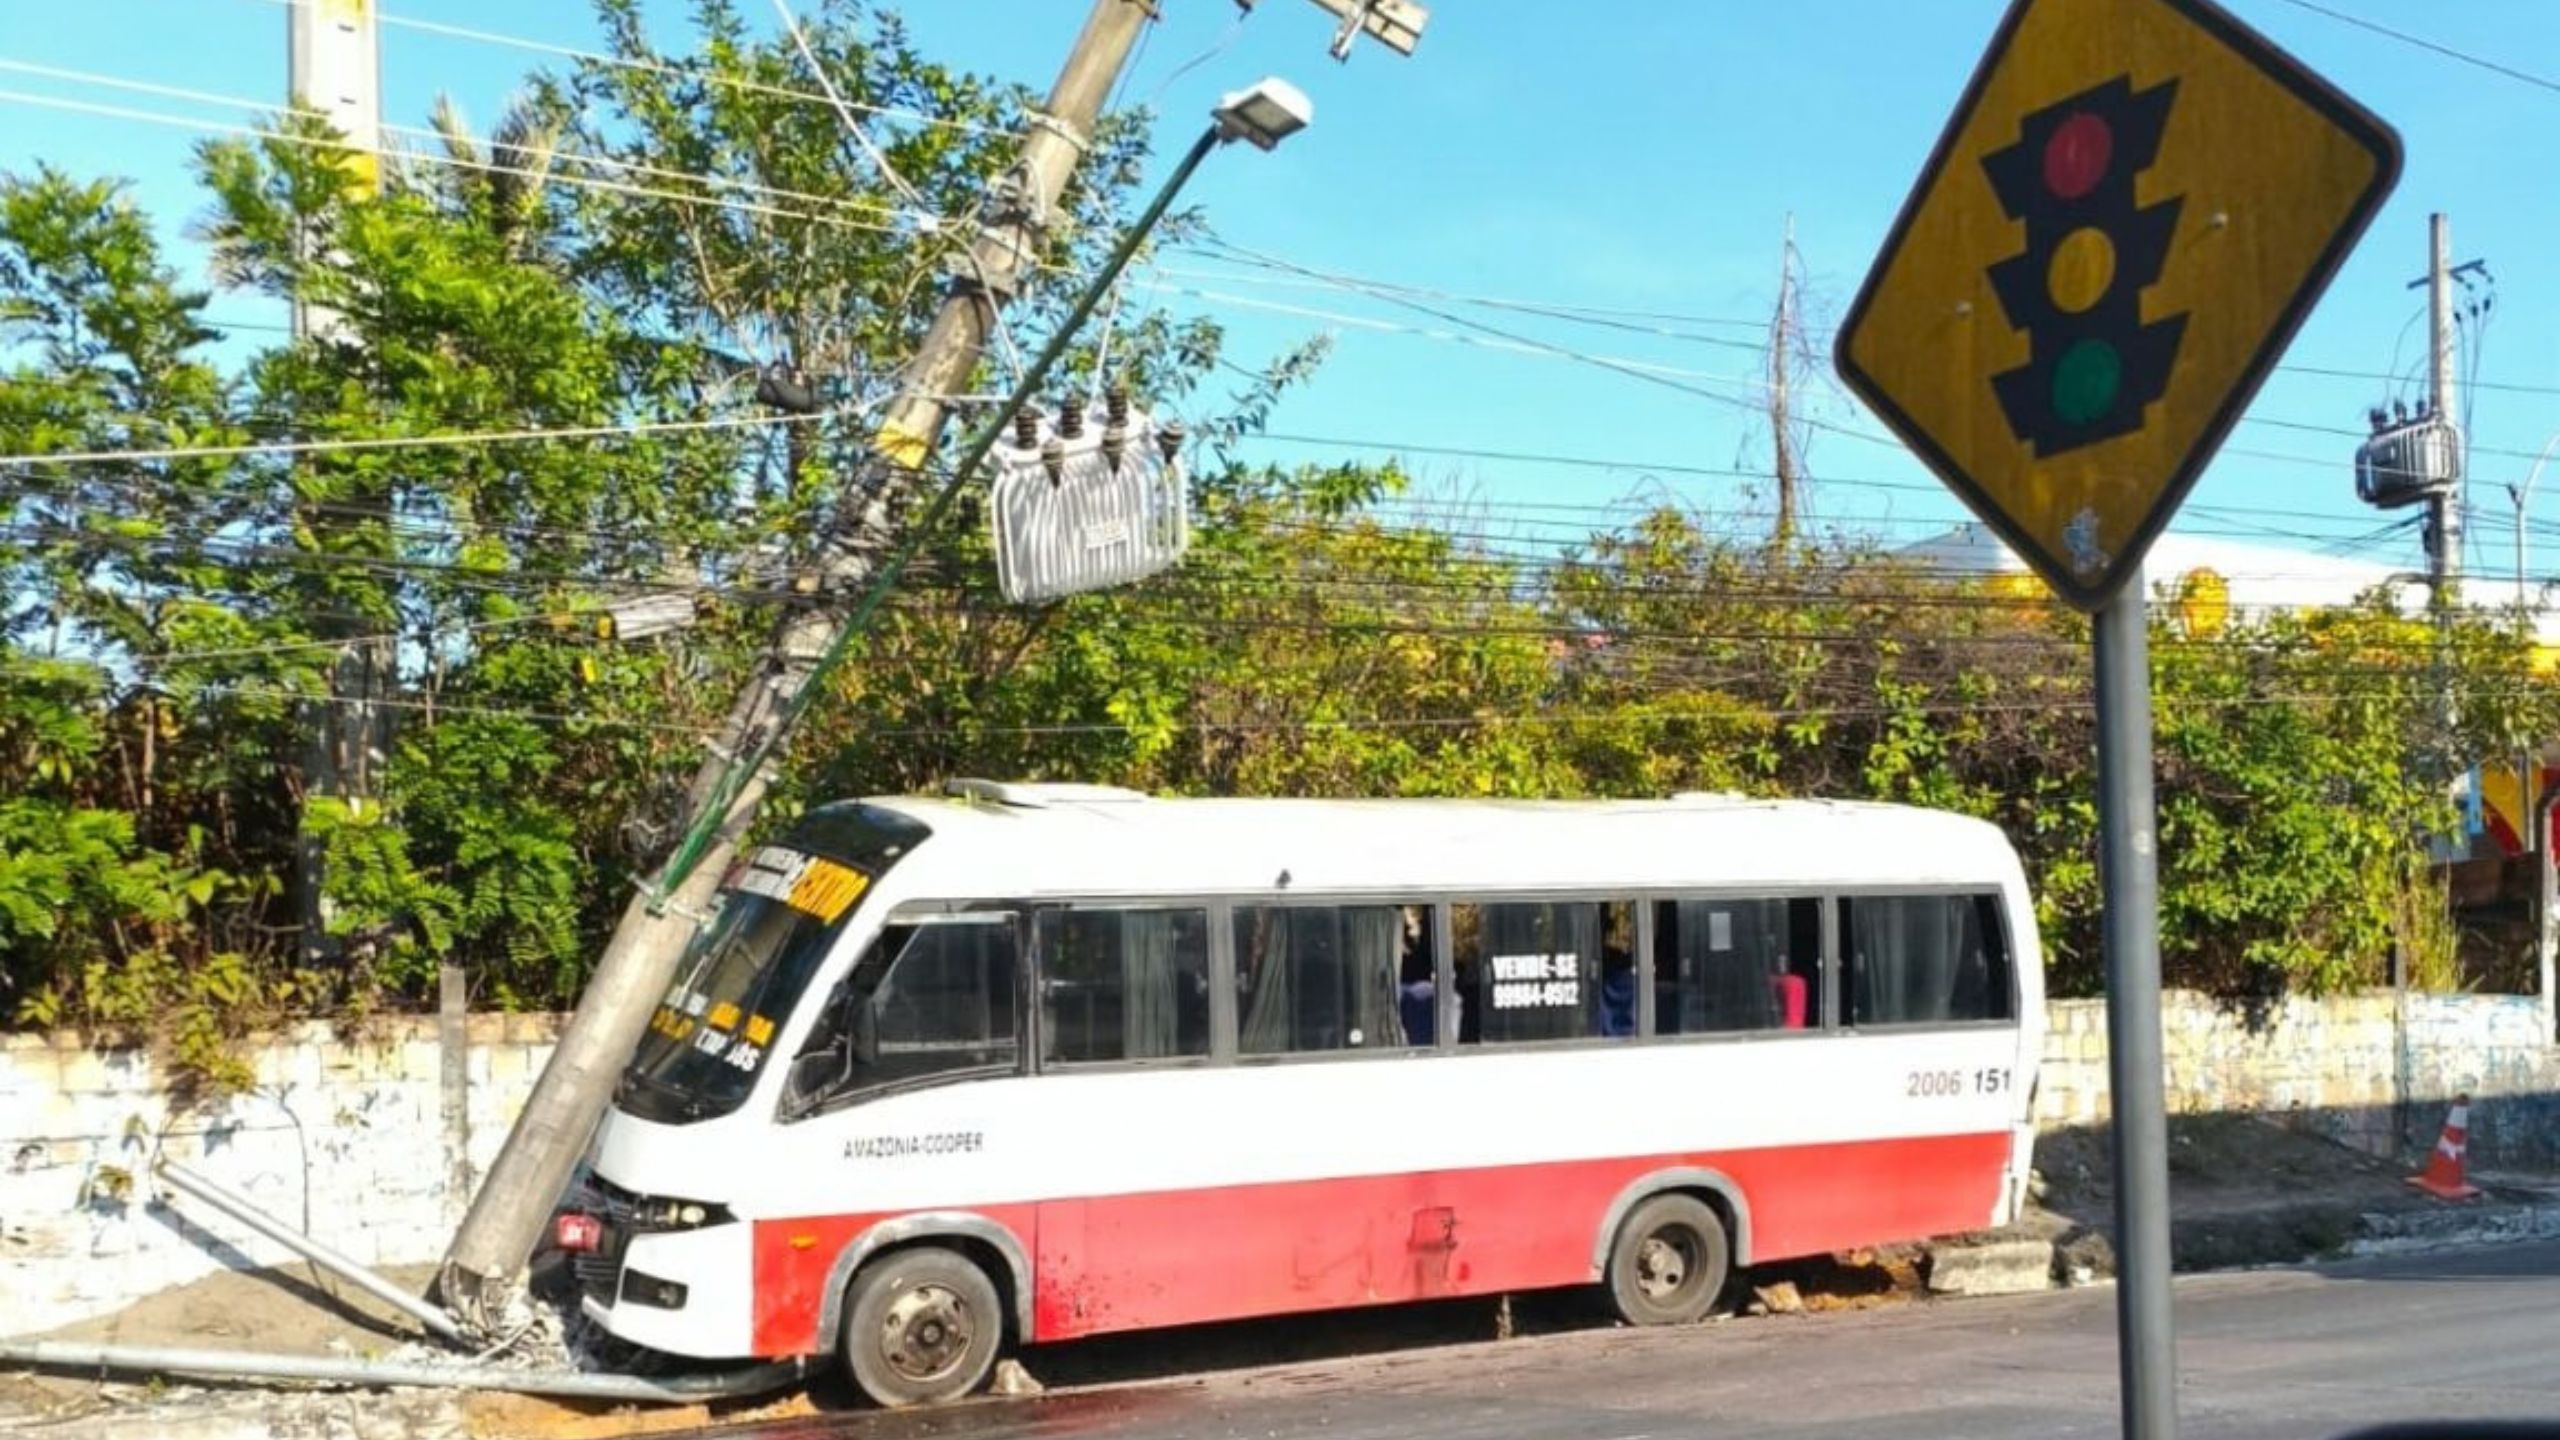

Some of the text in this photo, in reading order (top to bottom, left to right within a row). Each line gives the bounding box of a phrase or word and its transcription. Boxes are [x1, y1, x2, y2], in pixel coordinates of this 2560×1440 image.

[1493, 954, 1578, 979] VENDE-SE
[1907, 1068, 2011, 1096] 2006 151
